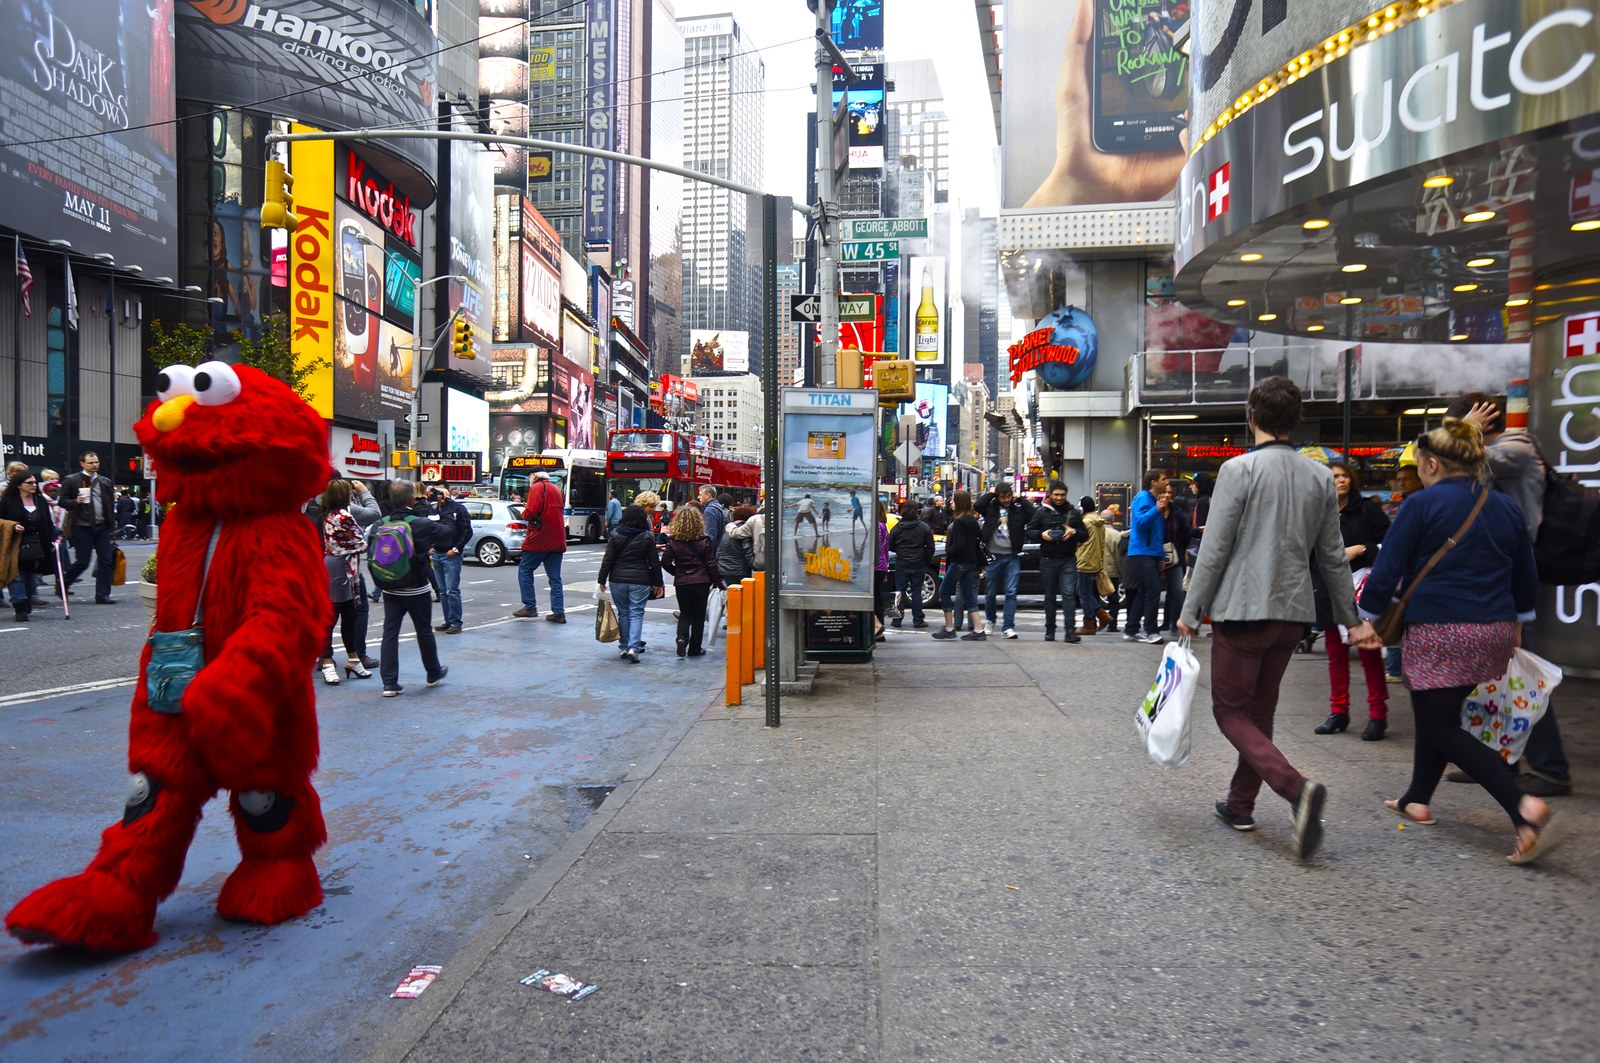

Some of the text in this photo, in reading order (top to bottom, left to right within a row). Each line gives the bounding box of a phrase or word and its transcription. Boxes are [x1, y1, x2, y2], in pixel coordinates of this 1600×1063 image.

[1109, 26, 1142, 50] TO
[34, 40, 129, 130] SHADOWS
[282, 41, 406, 98] driving emotion
[64, 190, 110, 226] MAY 11
[347, 149, 417, 247] Kodak
[855, 219, 926, 233] GEORGE ABBOTT
[843, 241, 897, 260] W 45 St
[295, 205, 330, 344] Kodak
[803, 303, 820, 315] ON
[1007, 326, 1055, 373] PLANET
[1009, 344, 1080, 390] HOLLYWOOD
[808, 394, 852, 406] TITAN
[23, 441, 45, 456] hut
